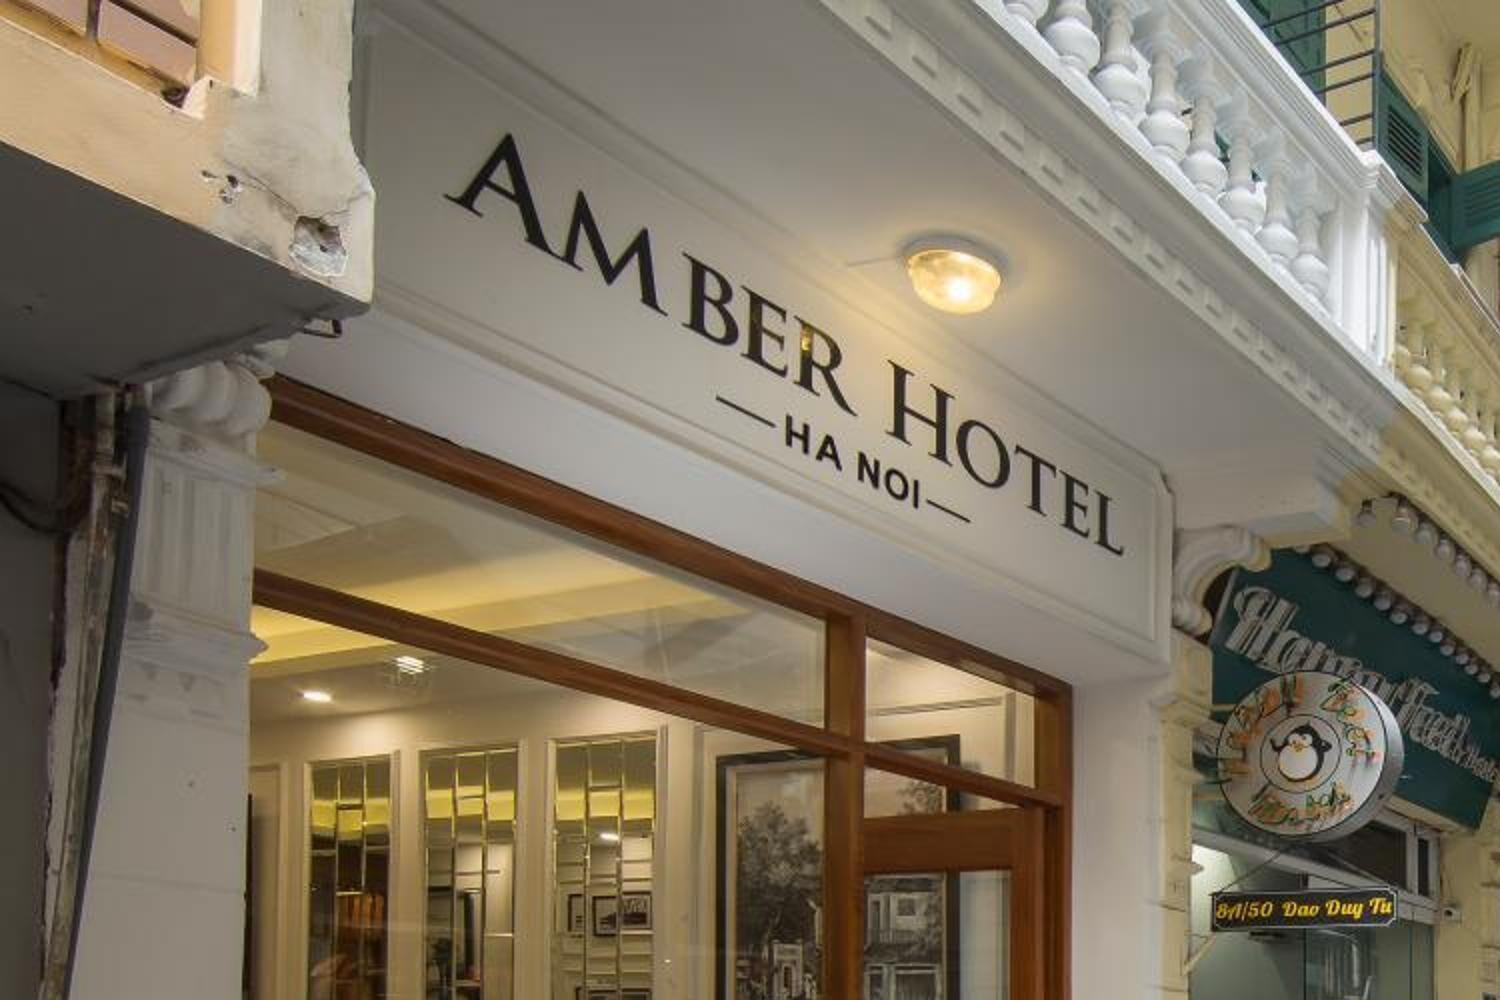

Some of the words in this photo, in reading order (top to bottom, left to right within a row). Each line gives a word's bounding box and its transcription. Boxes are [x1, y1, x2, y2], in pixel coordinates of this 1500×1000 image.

[443, 132, 858, 417] AMBER
[885, 359, 1126, 557] HOTEL
[784, 414, 842, 471] HA
[856, 458, 921, 509] NOI
[1282, 901, 1320, 918] Dao
[1326, 899, 1363, 920] Duy
[1369, 897, 1393, 914] Tu
